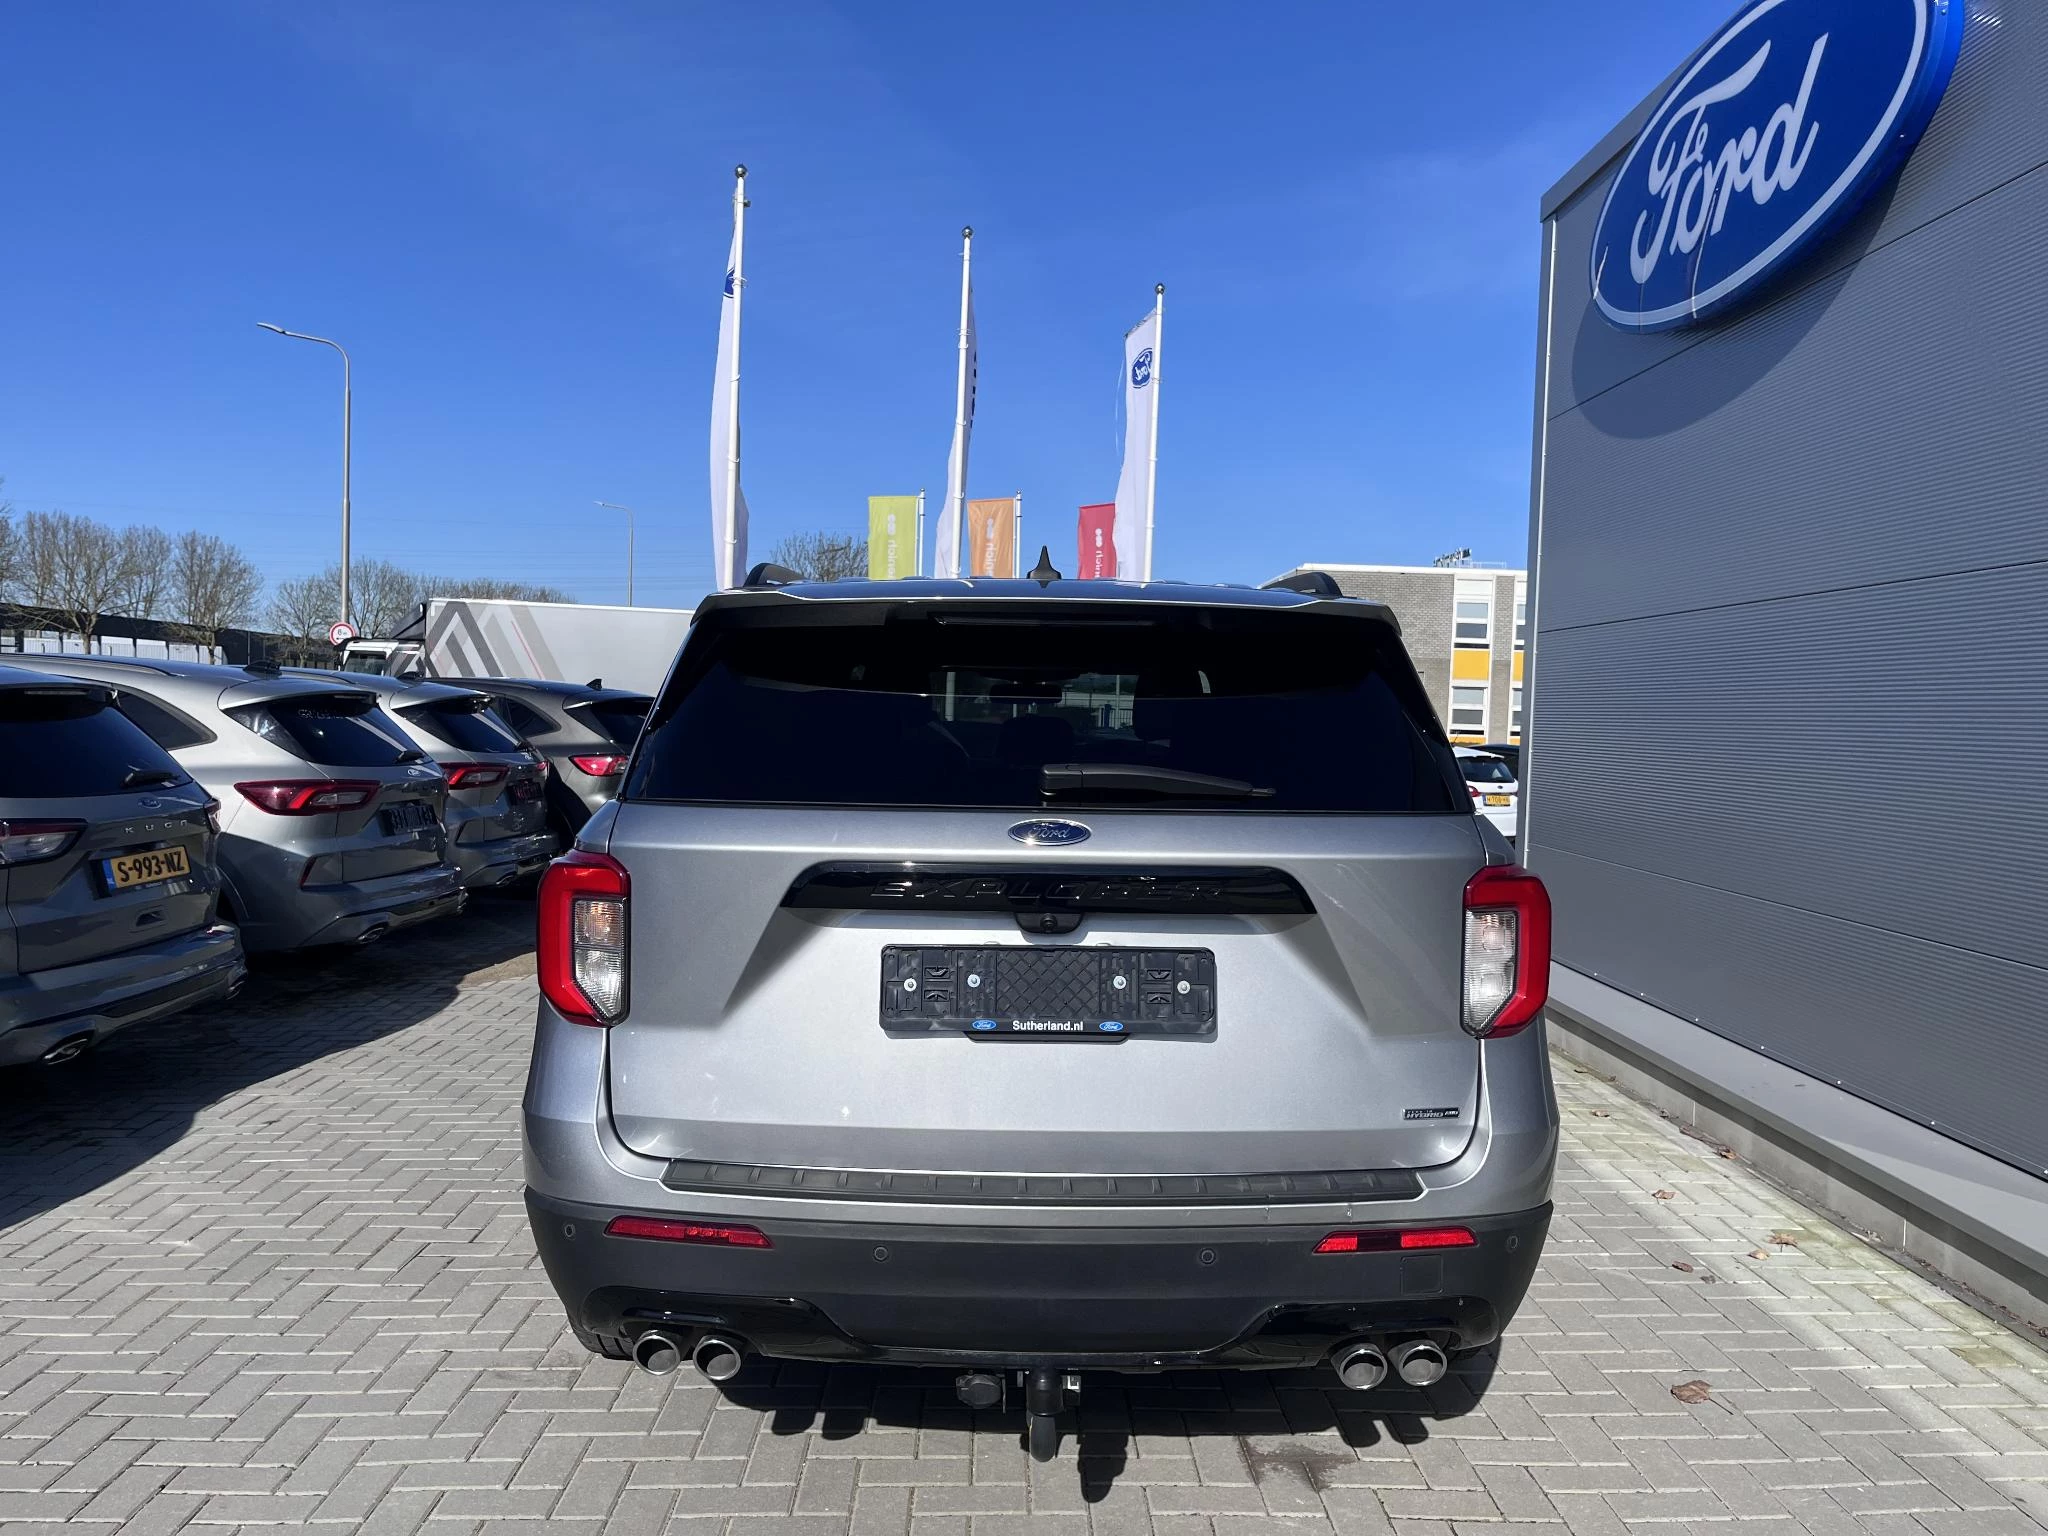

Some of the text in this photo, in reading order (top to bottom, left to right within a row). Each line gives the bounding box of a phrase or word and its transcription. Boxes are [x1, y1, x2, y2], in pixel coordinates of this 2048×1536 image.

[1630, 32, 1829, 284] Ford
[1027, 823, 1071, 838] Ford
[117, 851, 185, 883] S-993-NZ
[870, 878, 1223, 901] EXPLORER
[1012, 1020, 1083, 1031] Sutherland.nl
